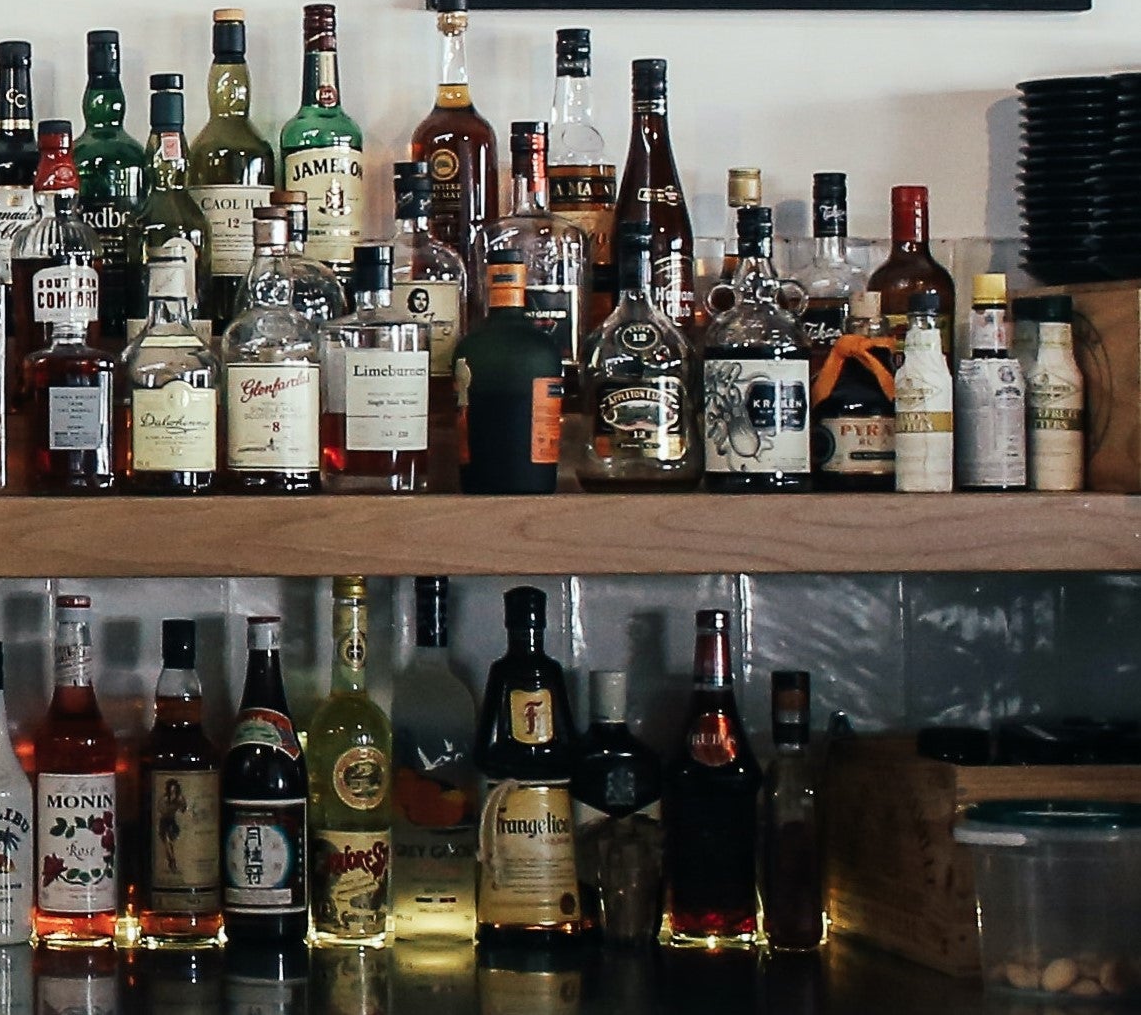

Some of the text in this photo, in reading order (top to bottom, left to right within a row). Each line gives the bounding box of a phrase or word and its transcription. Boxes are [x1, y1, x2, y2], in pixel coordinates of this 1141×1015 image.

[291, 158, 362, 181] JAMEON
[201, 198, 240, 210] CAOL
[227, 218, 240, 228] 12
[272, 421, 280, 432] 8
[46, 794, 113, 809] MONIN
[66, 841, 95, 862] Rose
